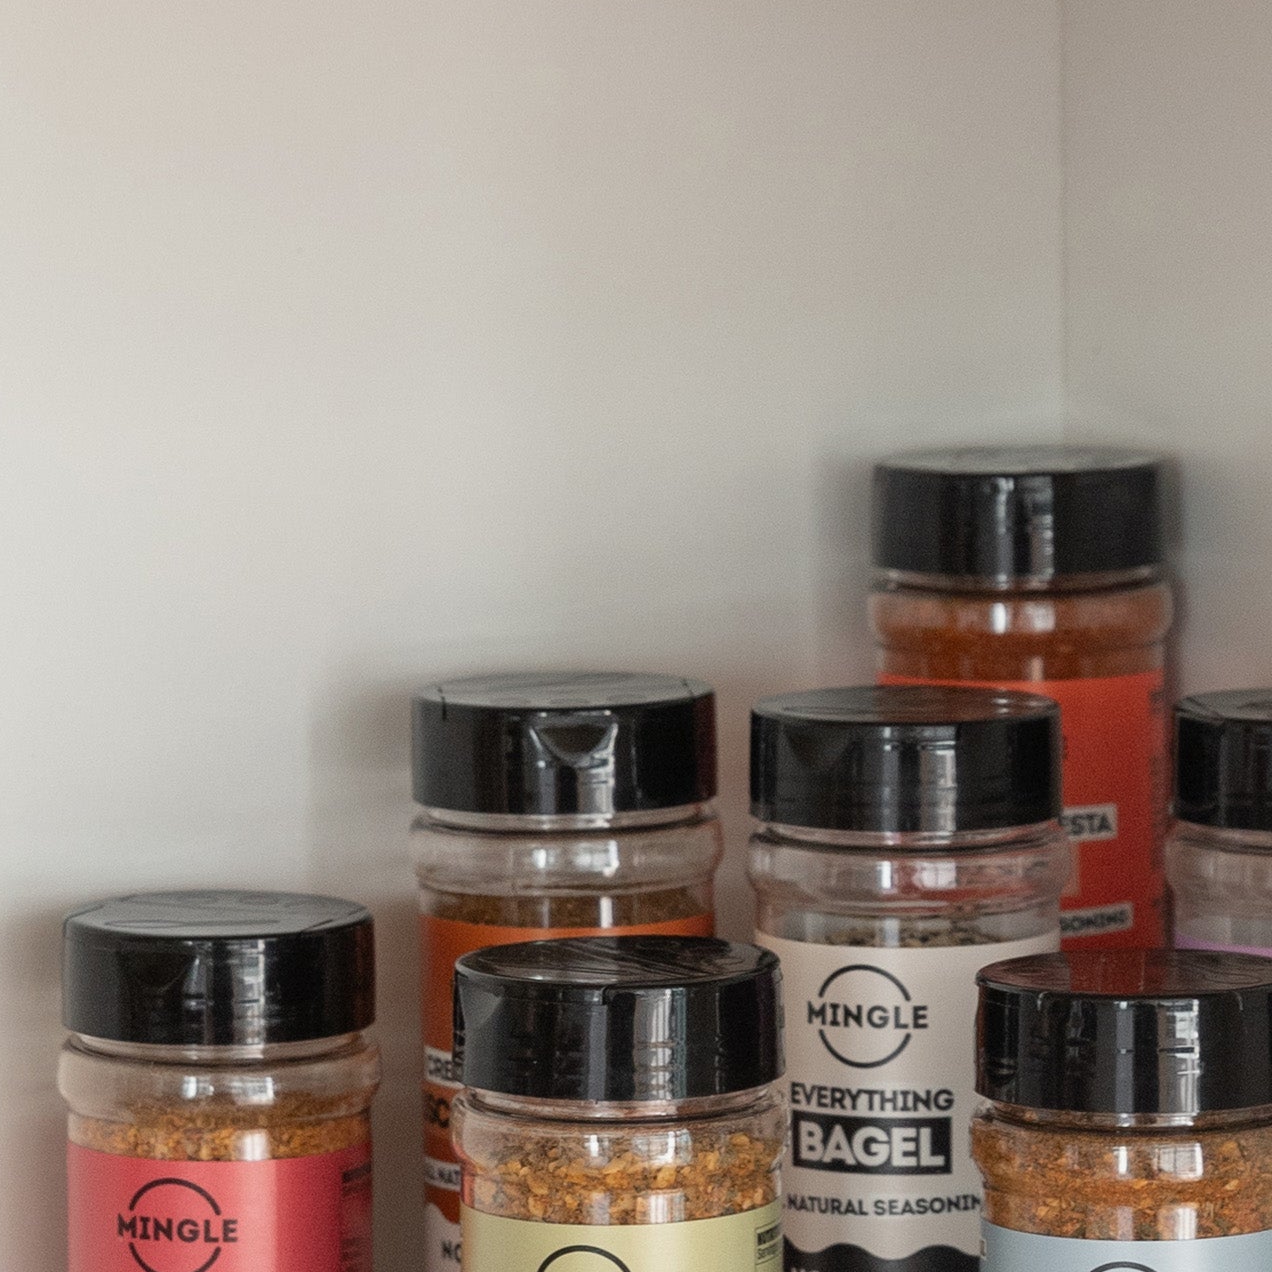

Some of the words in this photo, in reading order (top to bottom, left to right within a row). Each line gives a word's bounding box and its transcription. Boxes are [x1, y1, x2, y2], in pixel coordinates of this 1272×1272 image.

[807, 1000, 928, 1029] MINGLE
[790, 1082, 954, 1112] EVERYTHING
[799, 1120, 945, 1167] BAGEL
[787, 1193, 868, 1216] NATURAL
[874, 1194, 981, 1216] SEASONIN
[117, 1213, 239, 1243] MINGLE
